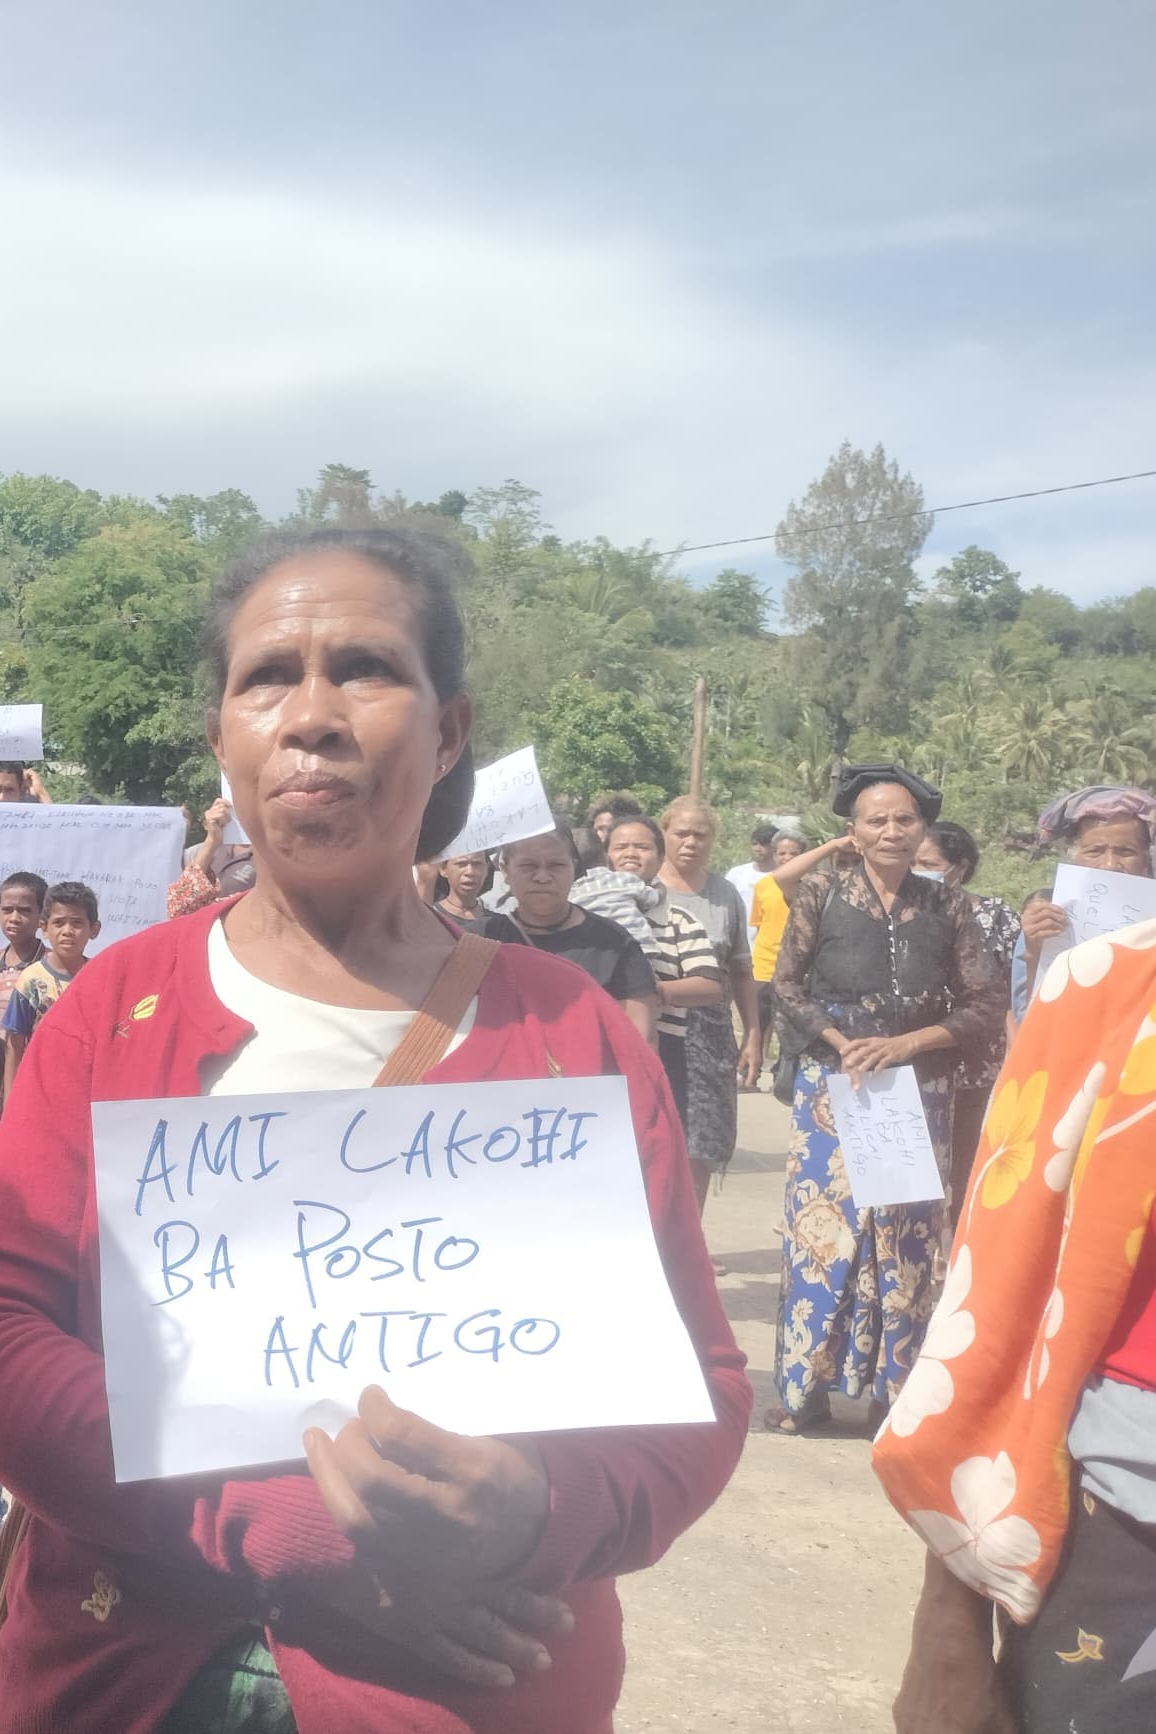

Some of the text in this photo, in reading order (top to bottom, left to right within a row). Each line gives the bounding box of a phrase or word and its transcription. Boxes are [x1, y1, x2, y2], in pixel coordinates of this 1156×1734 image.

[135, 1111, 287, 1216] AMI
[152, 1201, 479, 1308] BA POSTO
[263, 1309, 561, 1388] ANTIGO
